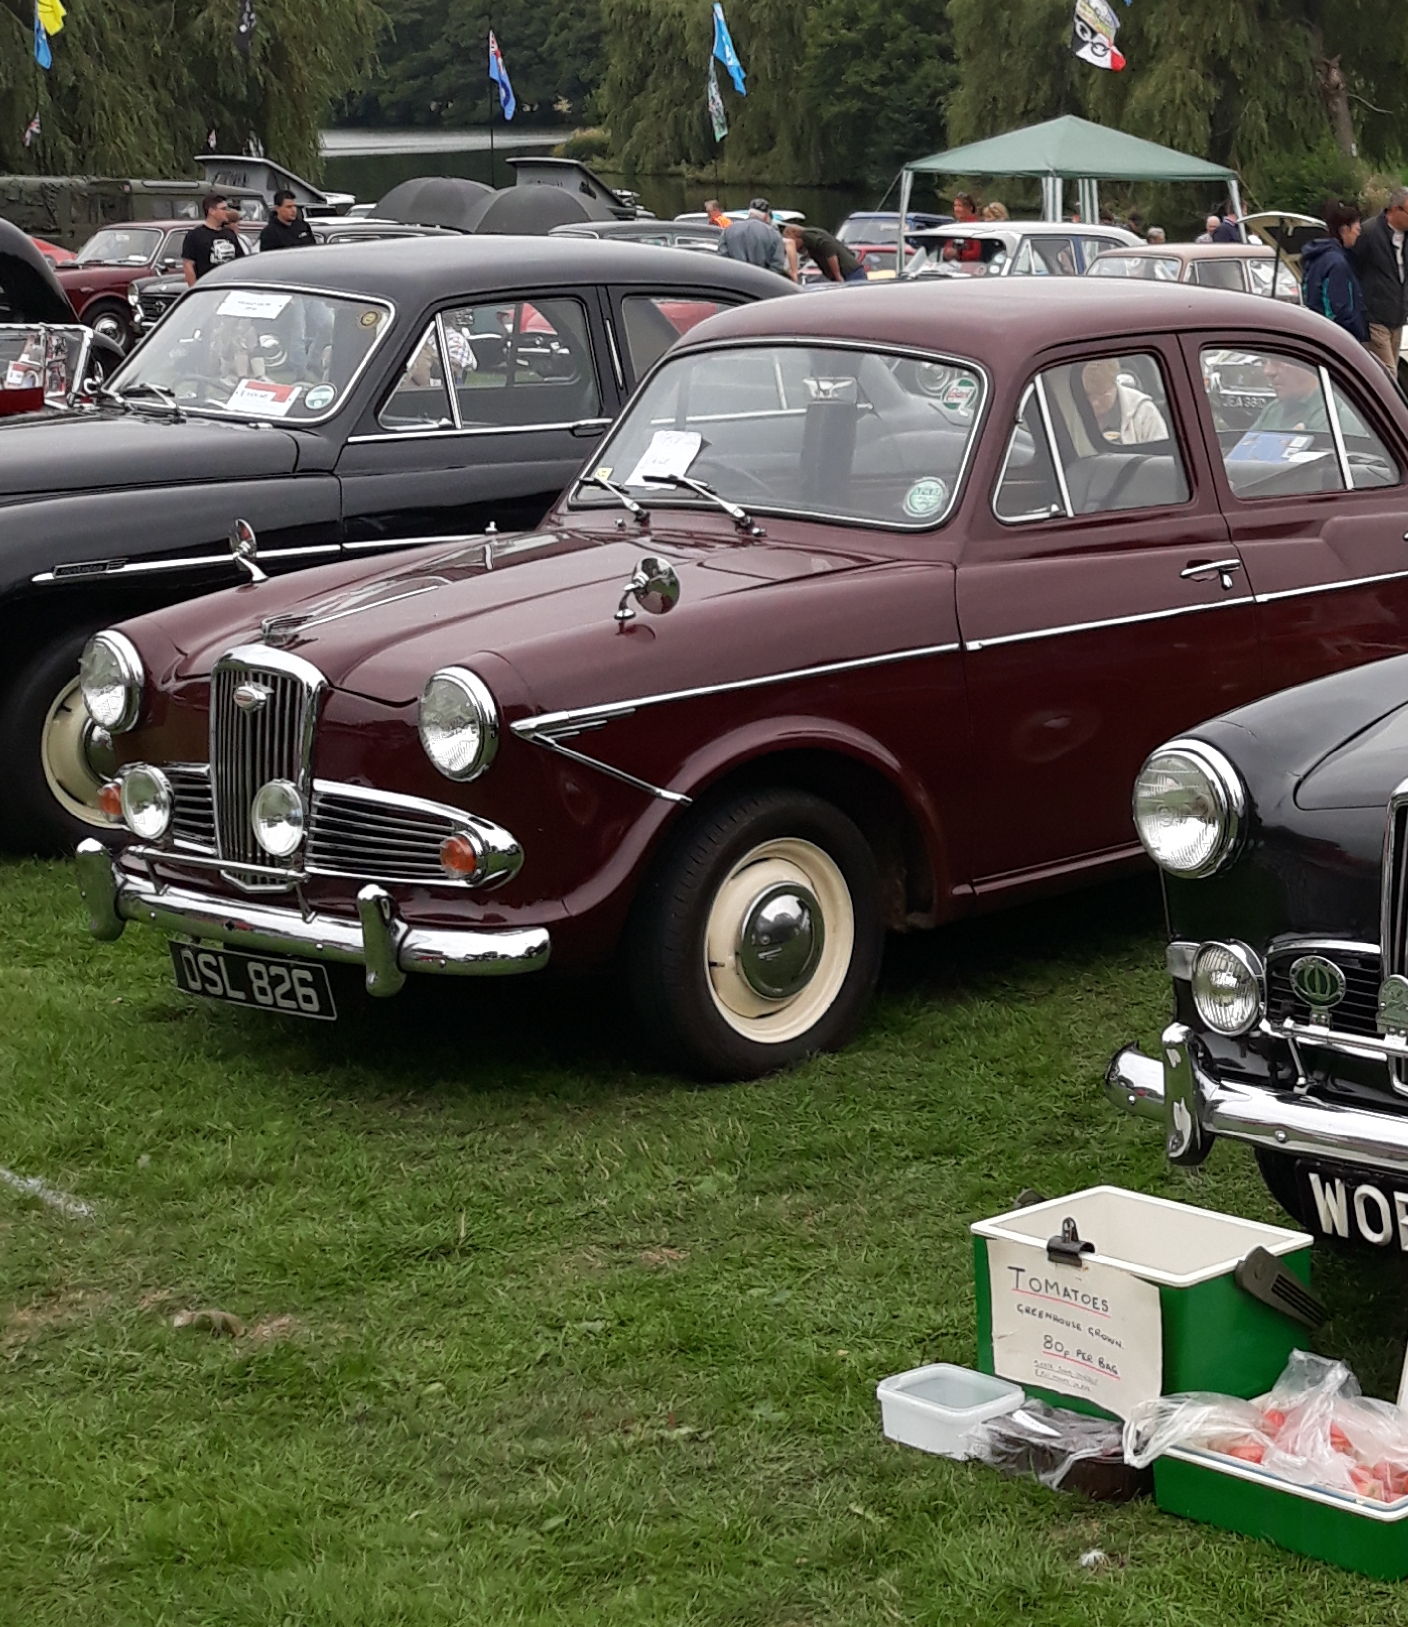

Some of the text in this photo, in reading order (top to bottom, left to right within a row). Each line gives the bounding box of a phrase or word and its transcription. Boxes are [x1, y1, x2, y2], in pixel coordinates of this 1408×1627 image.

[180, 948, 321, 1013] DSL 826
[1007, 1265, 1110, 1313] TOMATOES
[1016, 1303, 1083, 1331] GREENHOUSE
[1043, 1334, 1119, 1376] 80p PER BAG
